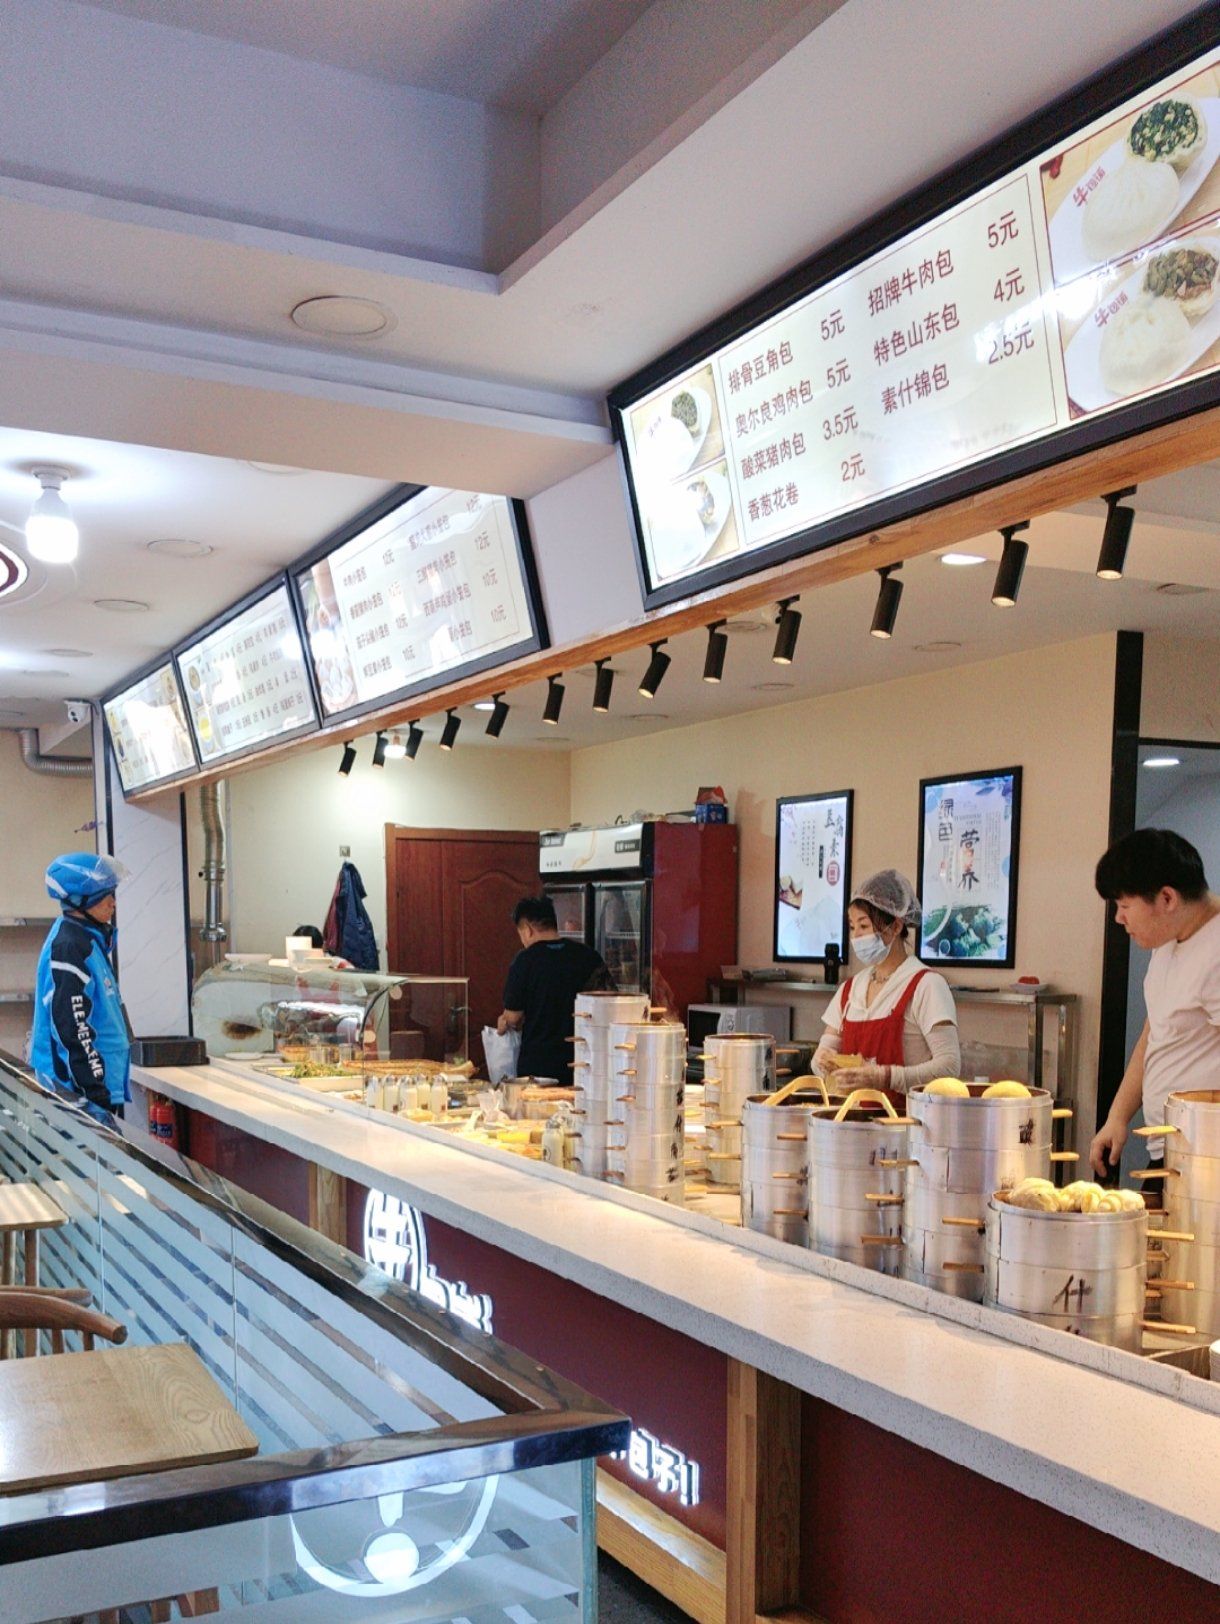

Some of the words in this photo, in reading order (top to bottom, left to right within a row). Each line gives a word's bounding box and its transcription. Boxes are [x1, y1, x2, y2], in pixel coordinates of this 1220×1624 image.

[867, 249, 954, 316] 招牌牛肉包
[987, 210, 1019, 248] 5元
[728, 341, 794, 395] 排骨豆角包
[820, 309, 845, 341] 5元
[873, 302, 960, 366] 特色山东包
[993, 267, 1025, 302] 4元
[735, 379, 814, 438] 奥尔良鸡肉包
[826, 358, 851, 389] 5元
[881, 363, 950, 415] 素什锦包
[988, 321, 1035, 365] 2.5元
[740, 432, 807, 480] 酸菜猪肉包
[822, 405, 859, 441] 3.5元
[747, 482, 799, 522] 香葱花卷
[840, 453, 866, 482] 2元
[1052, 1274, 1093, 1313] 什
